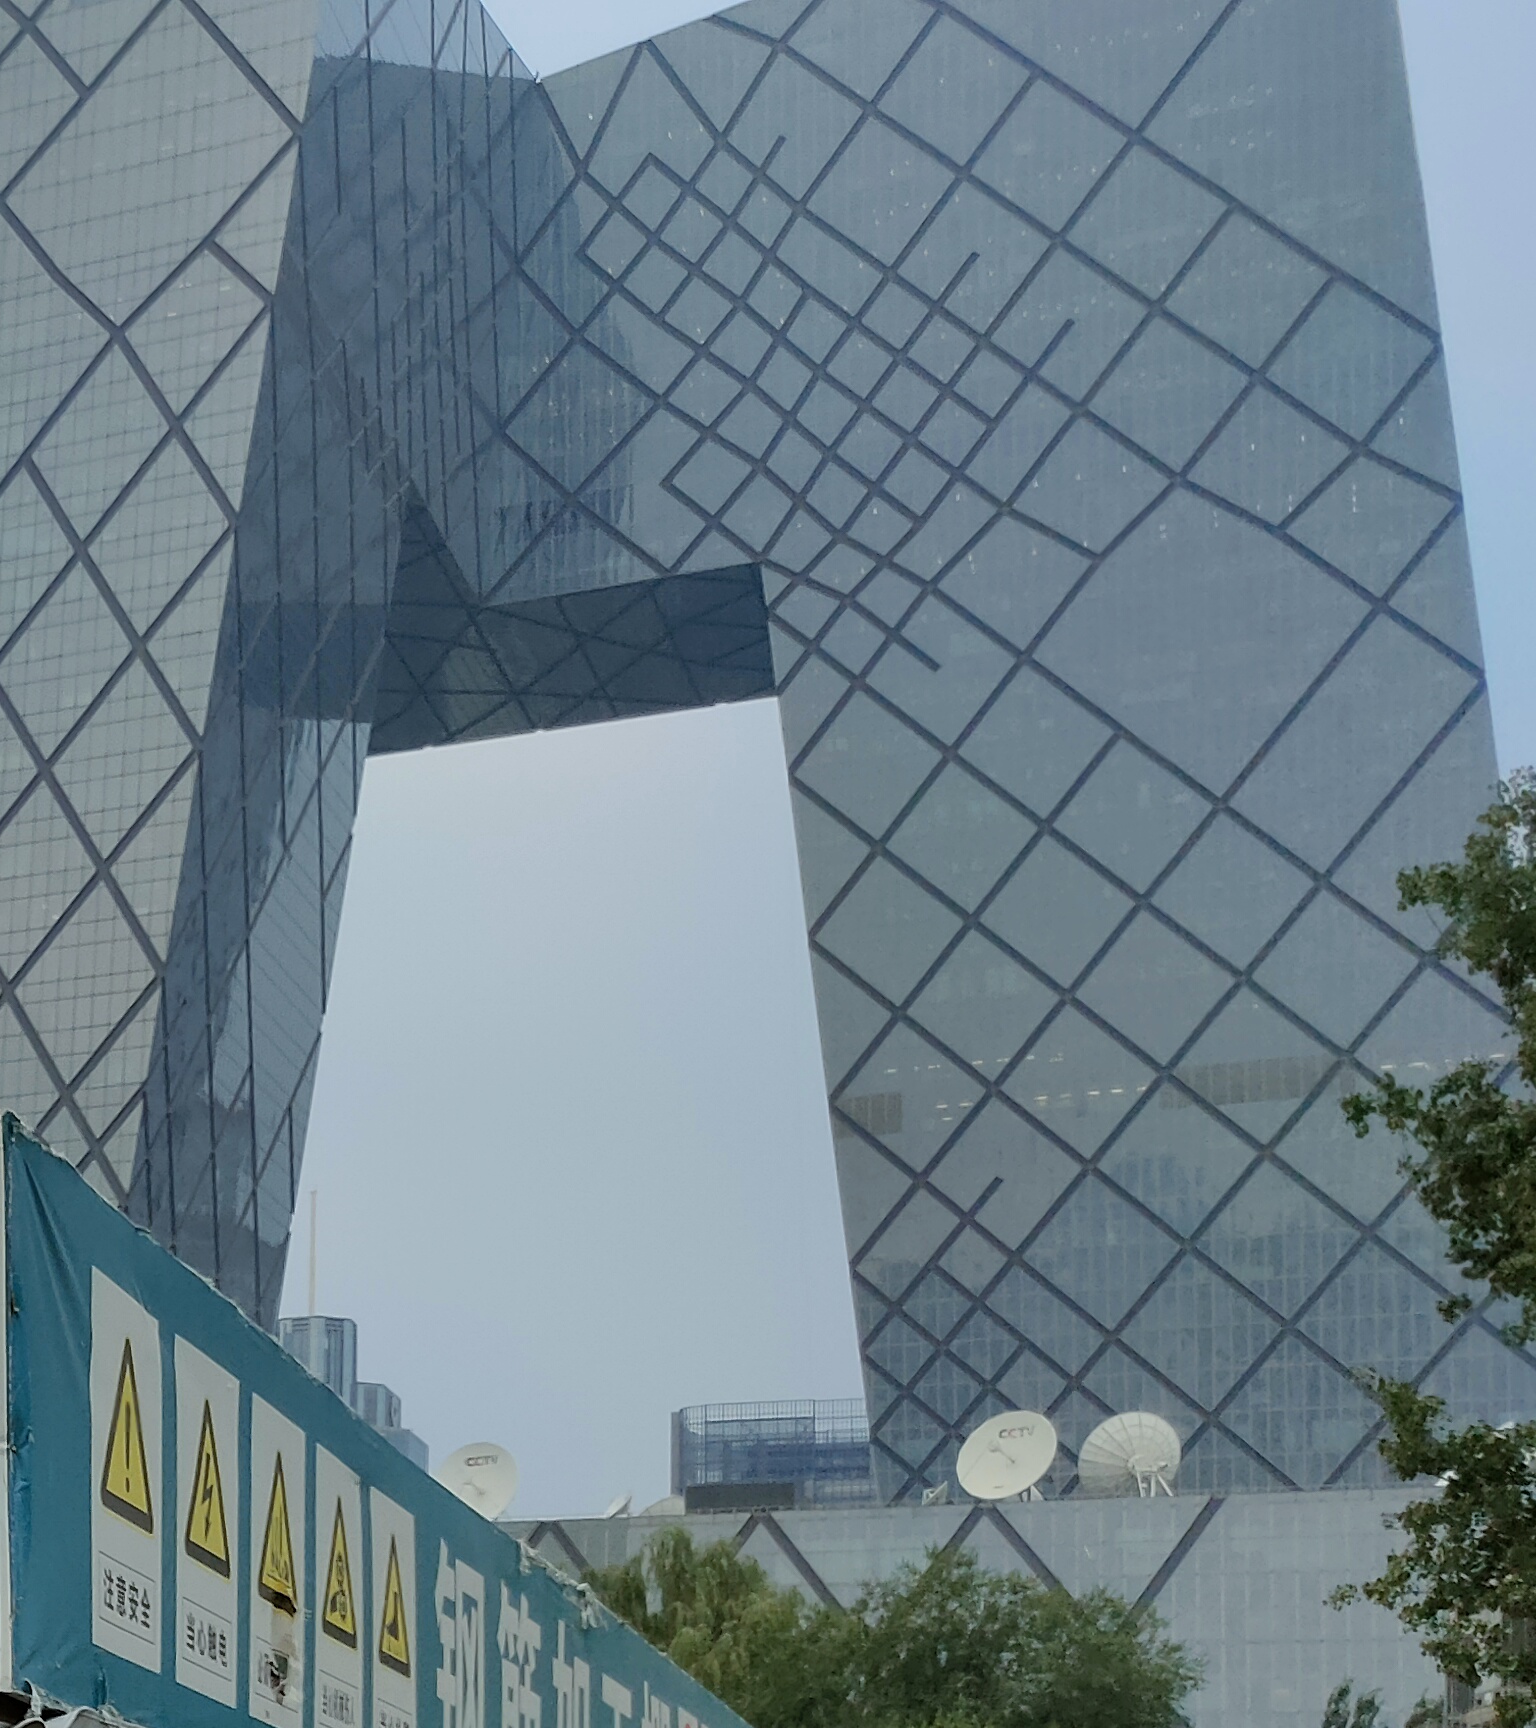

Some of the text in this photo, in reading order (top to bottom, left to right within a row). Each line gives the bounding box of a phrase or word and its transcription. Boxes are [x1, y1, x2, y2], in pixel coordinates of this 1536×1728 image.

[998, 1424, 1035, 1439] CCTV
[465, 1455, 498, 1467] CCTV
[103, 1567, 152, 1631] 注意安全
